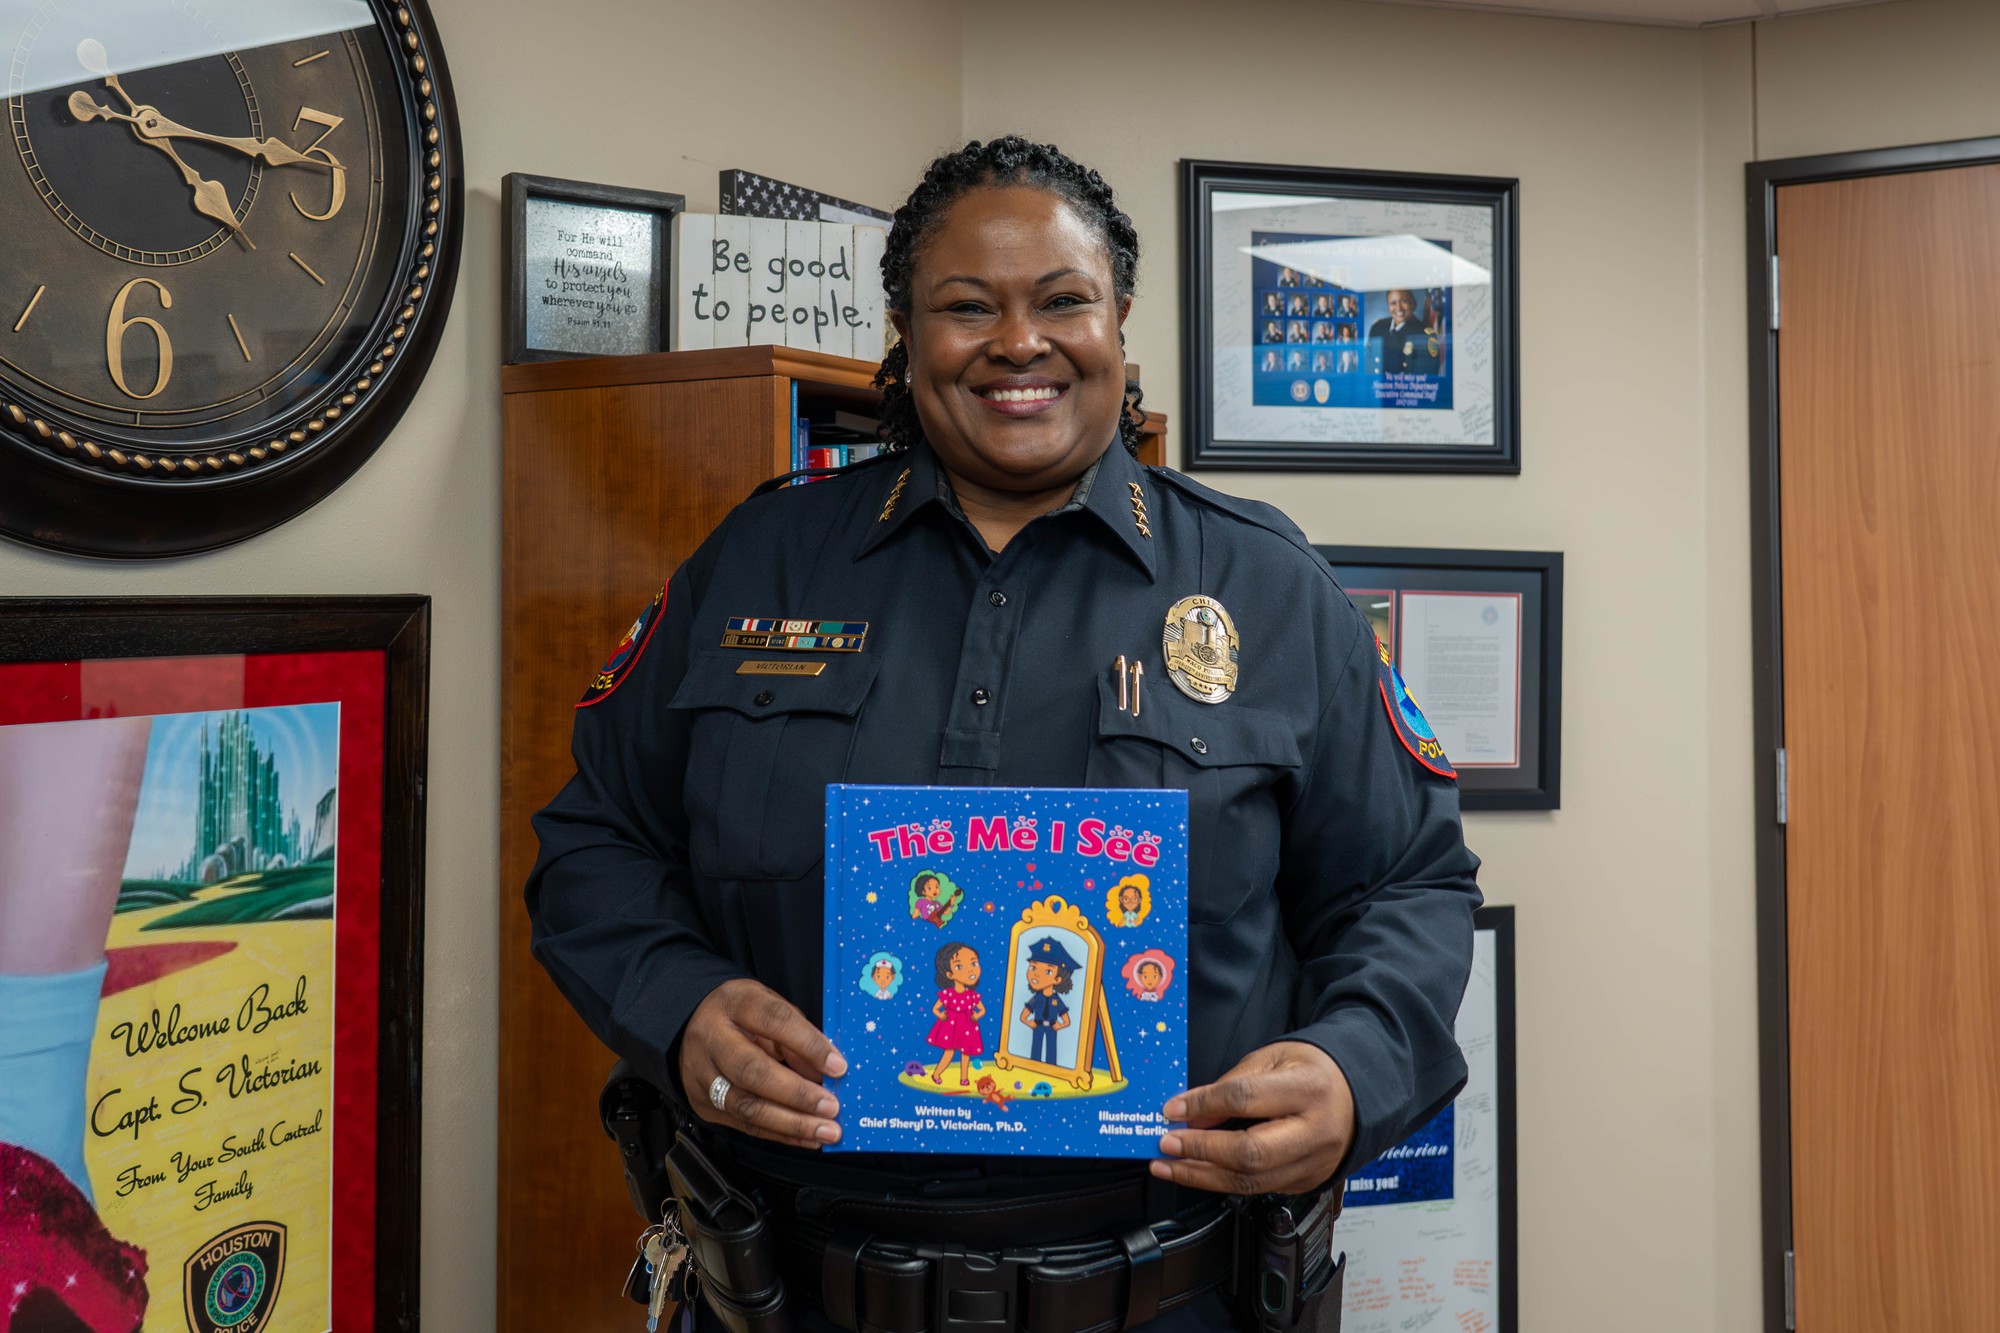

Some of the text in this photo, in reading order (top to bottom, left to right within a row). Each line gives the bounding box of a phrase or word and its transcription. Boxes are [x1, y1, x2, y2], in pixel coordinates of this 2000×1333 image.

[289, 105, 346, 221] 3
[558, 230, 623, 247] For He will
[566, 248, 613, 260] command
[554, 257, 627, 282] His angels
[712, 239, 850, 293] Be good
[545, 278, 631, 301] to protect you
[542, 295, 637, 318] wherever you go
[692, 283, 872, 344] to people.
[568, 317, 590, 325] Psalm
[105, 277, 173, 400] 6
[742, 636, 766, 644] SMIP
[756, 663, 806, 671] VICTORIAN
[868, 816, 1162, 868] The Me I See
[110, 975, 308, 1057] Welcome Back
[91, 1054, 322, 1140] Capt. S. Victorian
[915, 1106, 971, 1119] Written by
[1099, 1111, 1153, 1122] Illustrated
[859, 1117, 1027, 1132] Chief Sheryl D. Victorian, Ph.D.
[1099, 1124, 1133, 1135] Alisha
[116, 1109, 323, 1197] From Your South Central
[193, 1170, 253, 1211] Family
[1350, 1177, 1374, 1192] miss
[1375, 1175, 1399, 1192] you!
[200, 1232, 272, 1271] HOUSTON
